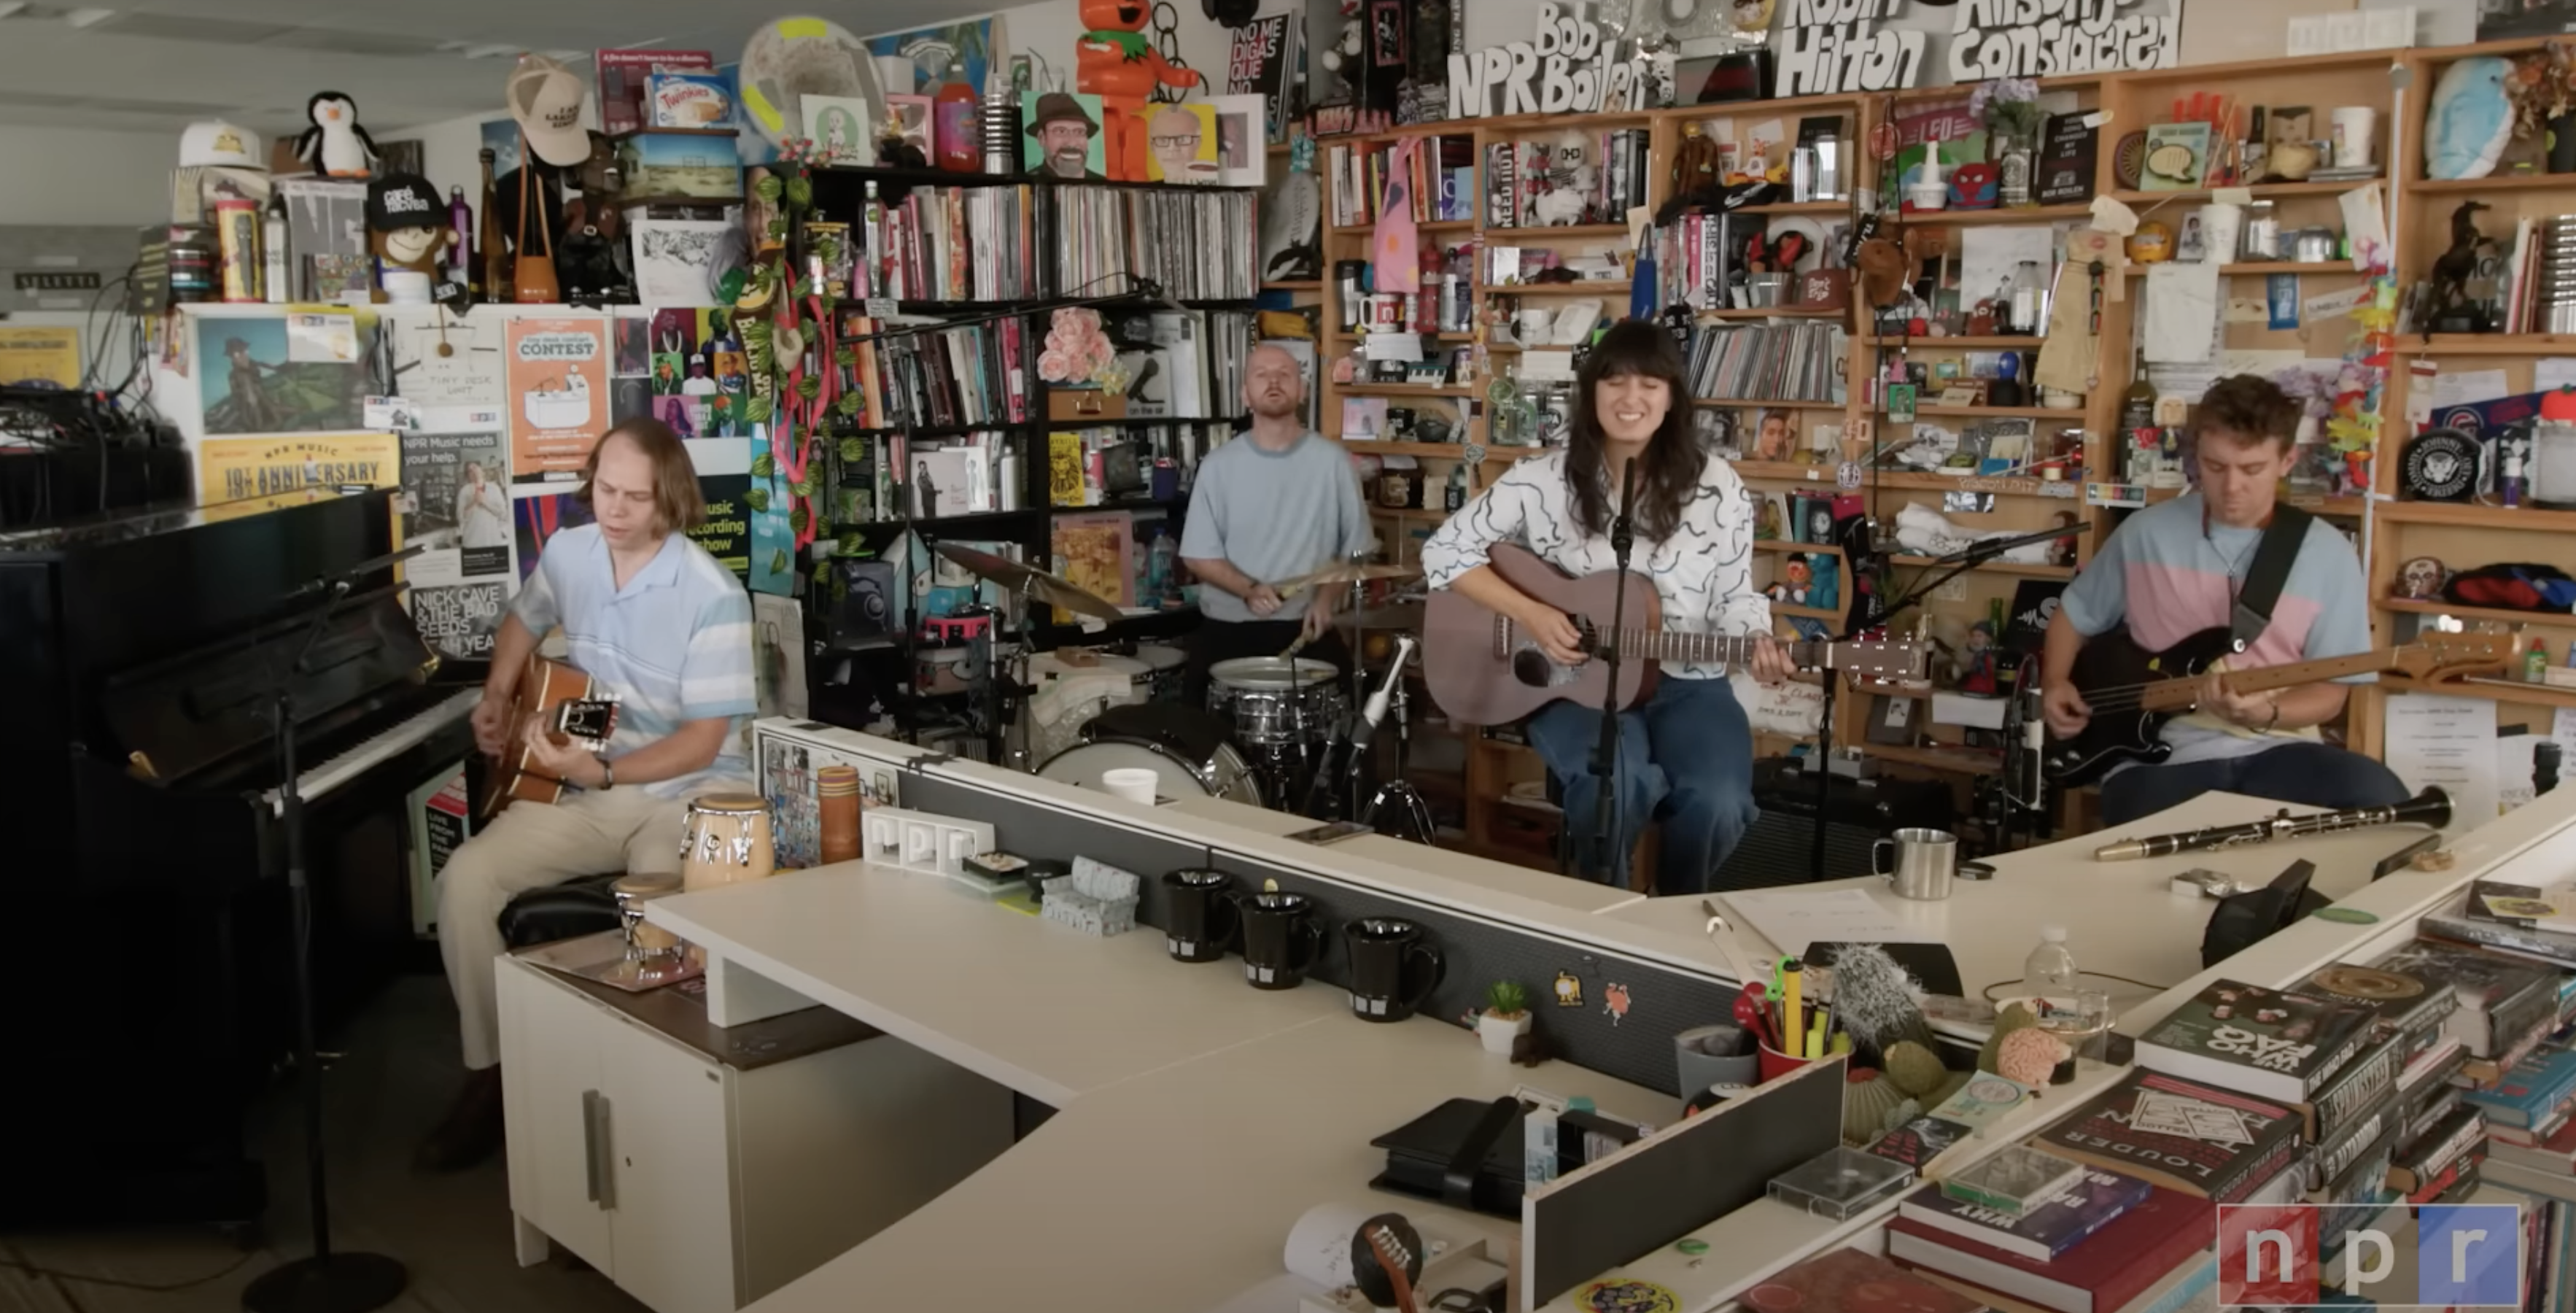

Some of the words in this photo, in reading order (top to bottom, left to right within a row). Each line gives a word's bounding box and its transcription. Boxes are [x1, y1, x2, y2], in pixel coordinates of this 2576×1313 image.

[1234, 23, 1257, 43] NO
[1260, 18, 1283, 39] ME
[1536, 1, 1599, 61] Bob
[1233, 39, 1277, 62] DIGAS
[1775, 23, 1926, 98] Hilton
[1230, 60, 1262, 81] QUE
[1447, 42, 1540, 119] NPR
[1540, 39, 1647, 113] Boilen
[659, 85, 710, 109] Twinkies
[1229, 82, 1252, 94] NO
[384, 185, 414, 201] café
[520, 343, 594, 355] CONTEST
[430, 376, 458, 385] TINY
[465, 376, 492, 385] DESK
[1129, 407, 1139, 415] on
[1141, 406, 1153, 414] the
[264, 446, 290, 460] NPR
[296, 443, 338, 456] MUSIC
[403, 438, 427, 450] NPR
[430, 437, 461, 449] Music
[462, 435, 494, 447] needs
[2420, 437, 2464, 452] JOHNNY
[404, 454, 430, 467] your
[431, 452, 458, 465] help.
[705, 500, 734, 516] usic
[686, 518, 746, 538] ecording
[414, 589, 456, 608] NICK
[458, 585, 501, 605] CAVE
[463, 602, 498, 619] BAD
[416, 619, 472, 638] SEEDS
[464, 634, 495, 651] YEA
[871, 816, 975, 862] npr
[2212, 1023, 2317, 1058] FAQ
[2206, 1037, 2303, 1069] WHO
[2340, 1041, 2355, 1065] FAQ
[2065, 1131, 2214, 1178] LOUDER
[1951, 1204, 2017, 1230] WHY
